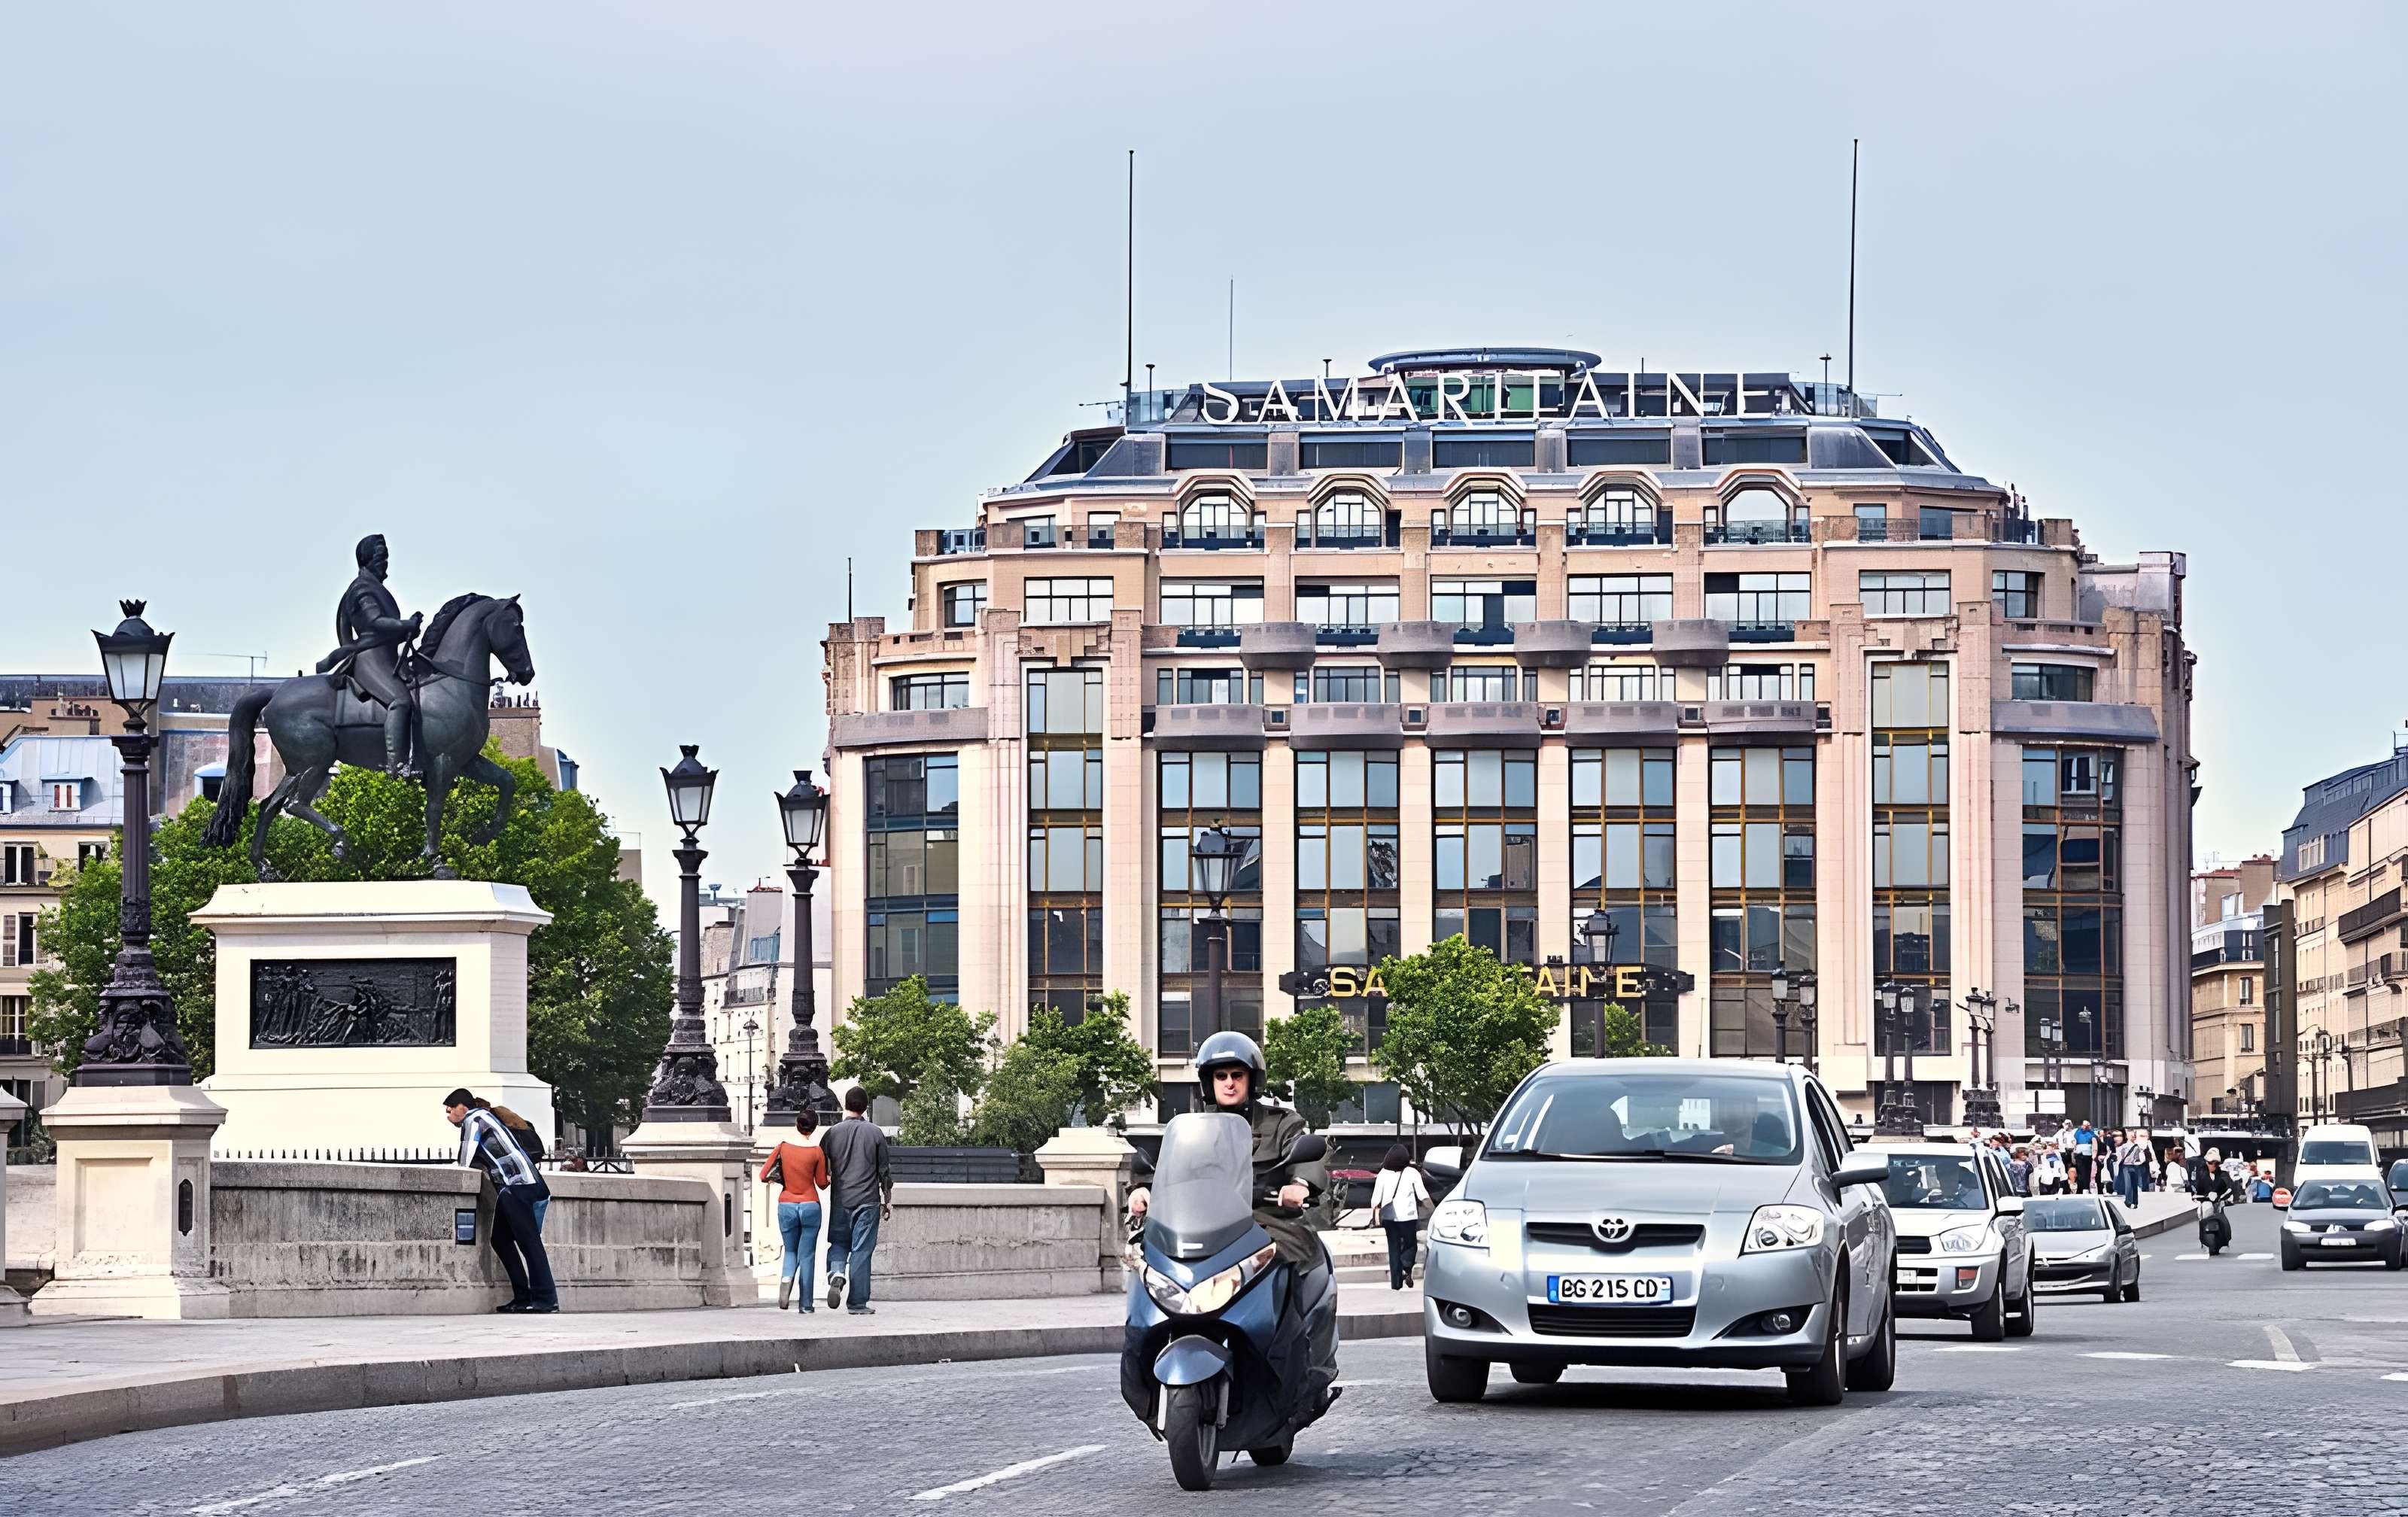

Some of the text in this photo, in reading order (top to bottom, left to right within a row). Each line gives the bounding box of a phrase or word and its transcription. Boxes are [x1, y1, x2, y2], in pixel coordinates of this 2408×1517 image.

[1202, 371, 1771, 427] SAMARITAINE
[1330, 966, 1643, 998] SAAINE
[1592, 1279, 1628, 1298] 215
[1634, 1279, 1658, 1298] CD
